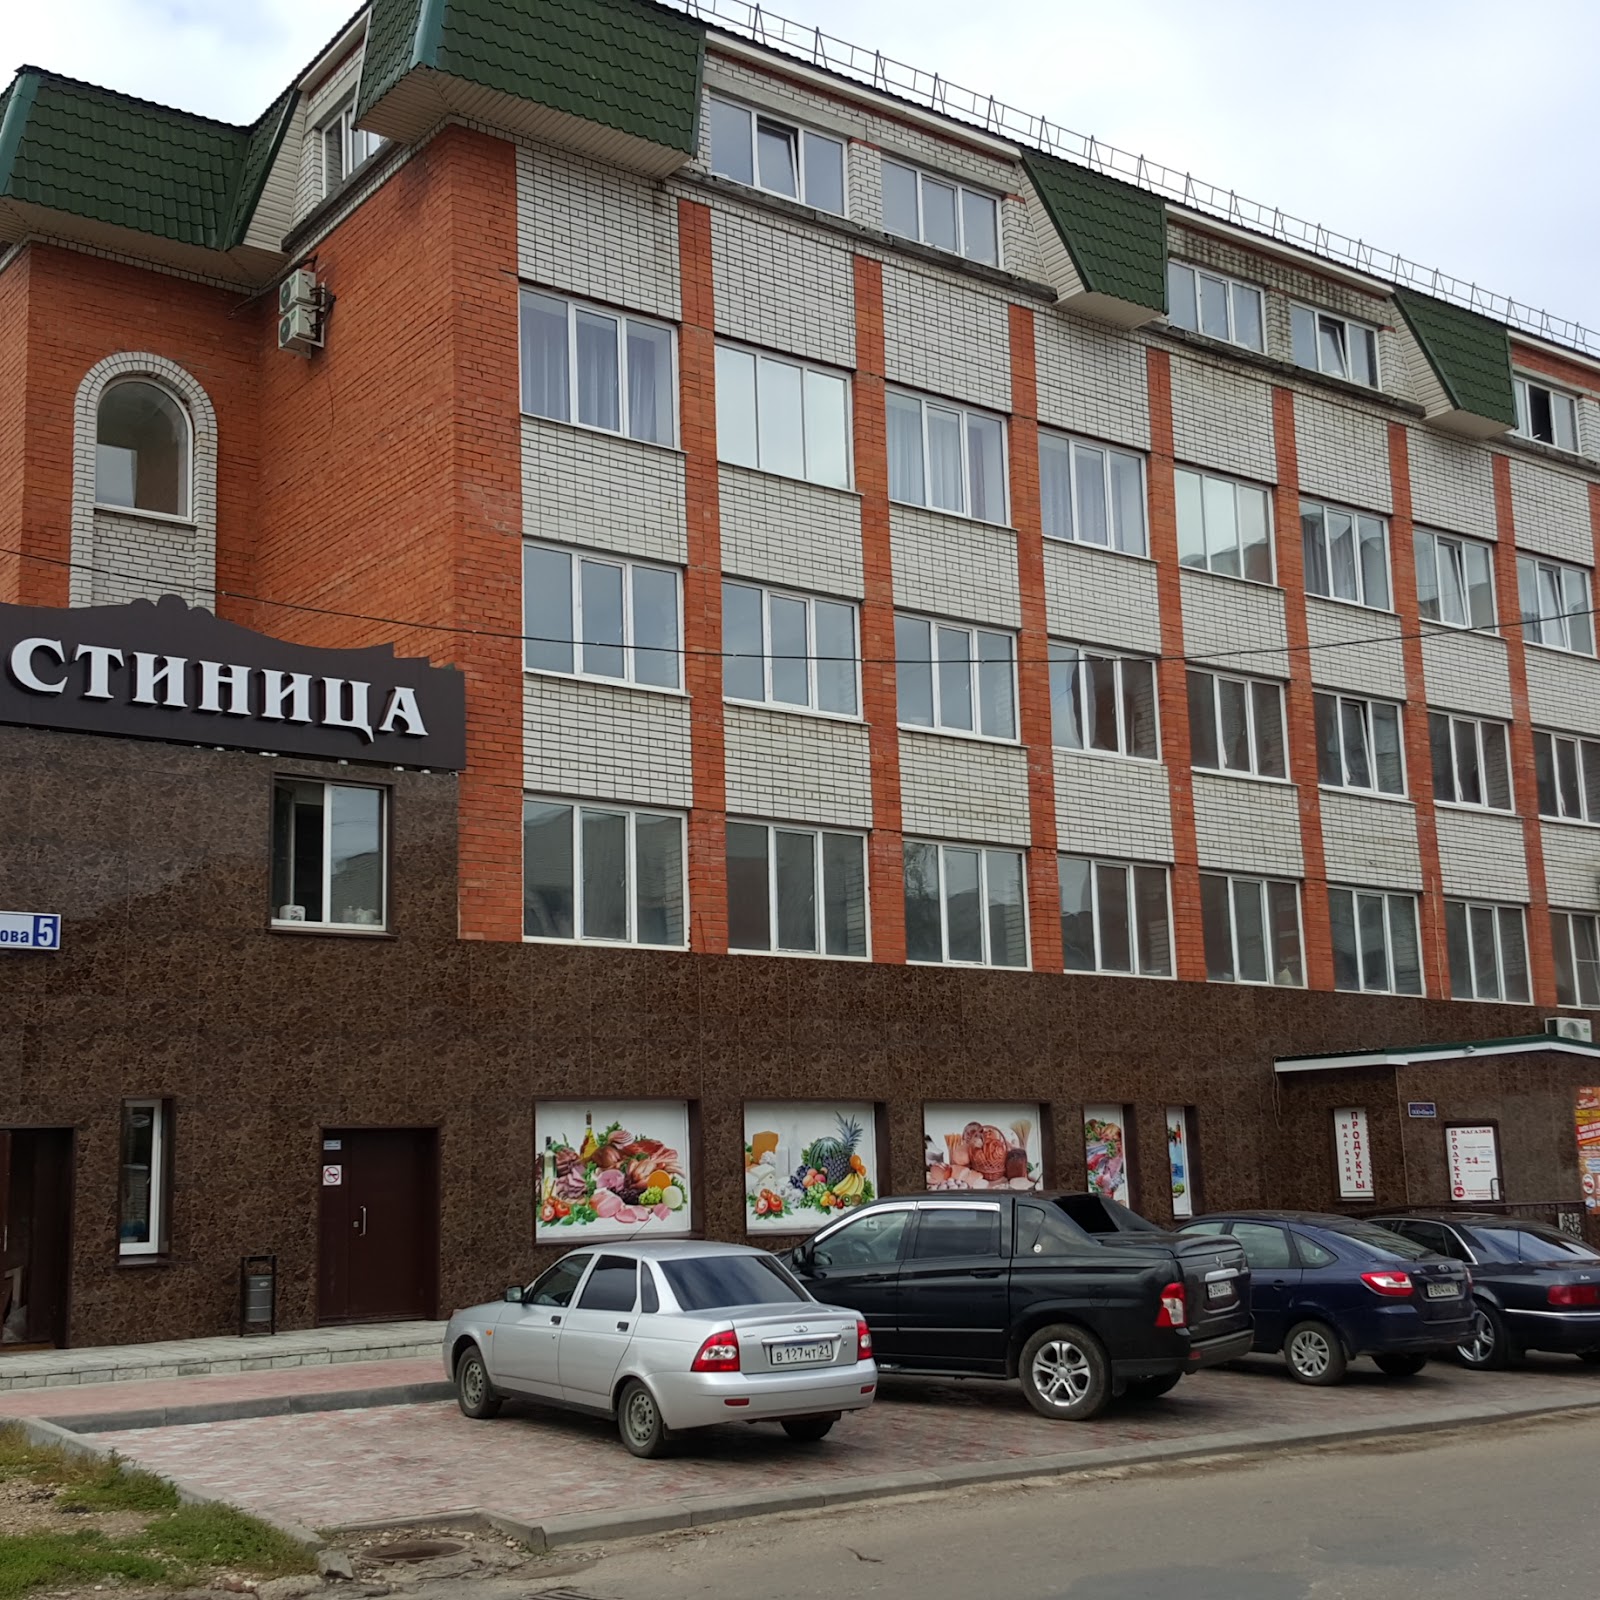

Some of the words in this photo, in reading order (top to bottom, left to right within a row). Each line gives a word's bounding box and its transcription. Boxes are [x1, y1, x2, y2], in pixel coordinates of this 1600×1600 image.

[10, 637, 429, 743] СТИНИЦА
[0, 929, 29, 943] ова
[38, 918, 54, 947] 5
[1342, 1124, 1352, 1181] МАГАЗИН
[1351, 1111, 1365, 1189] ПРОДУКТЫ
[1451, 1130, 1462, 1185] ПРОДУКТЫ
